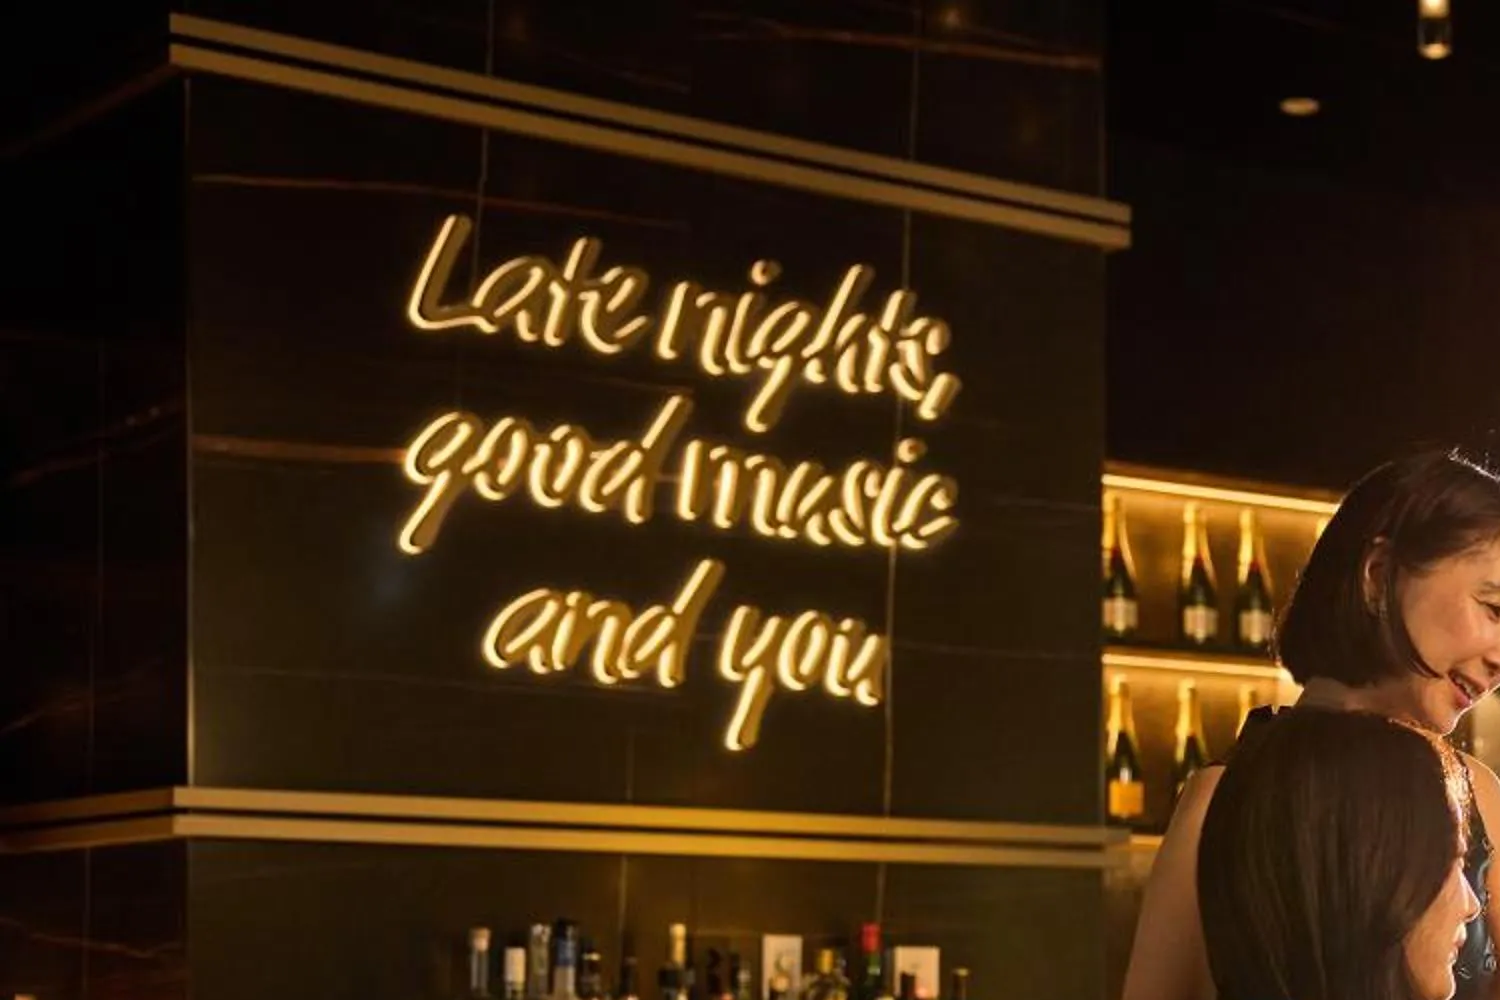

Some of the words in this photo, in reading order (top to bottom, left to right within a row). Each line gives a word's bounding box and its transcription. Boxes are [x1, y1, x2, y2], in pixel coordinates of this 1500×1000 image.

[406, 213, 648, 353] Late
[398, 396, 697, 555] good
[678, 438, 958, 550] music
[482, 559, 726, 688] and
[718, 605, 886, 751] you
